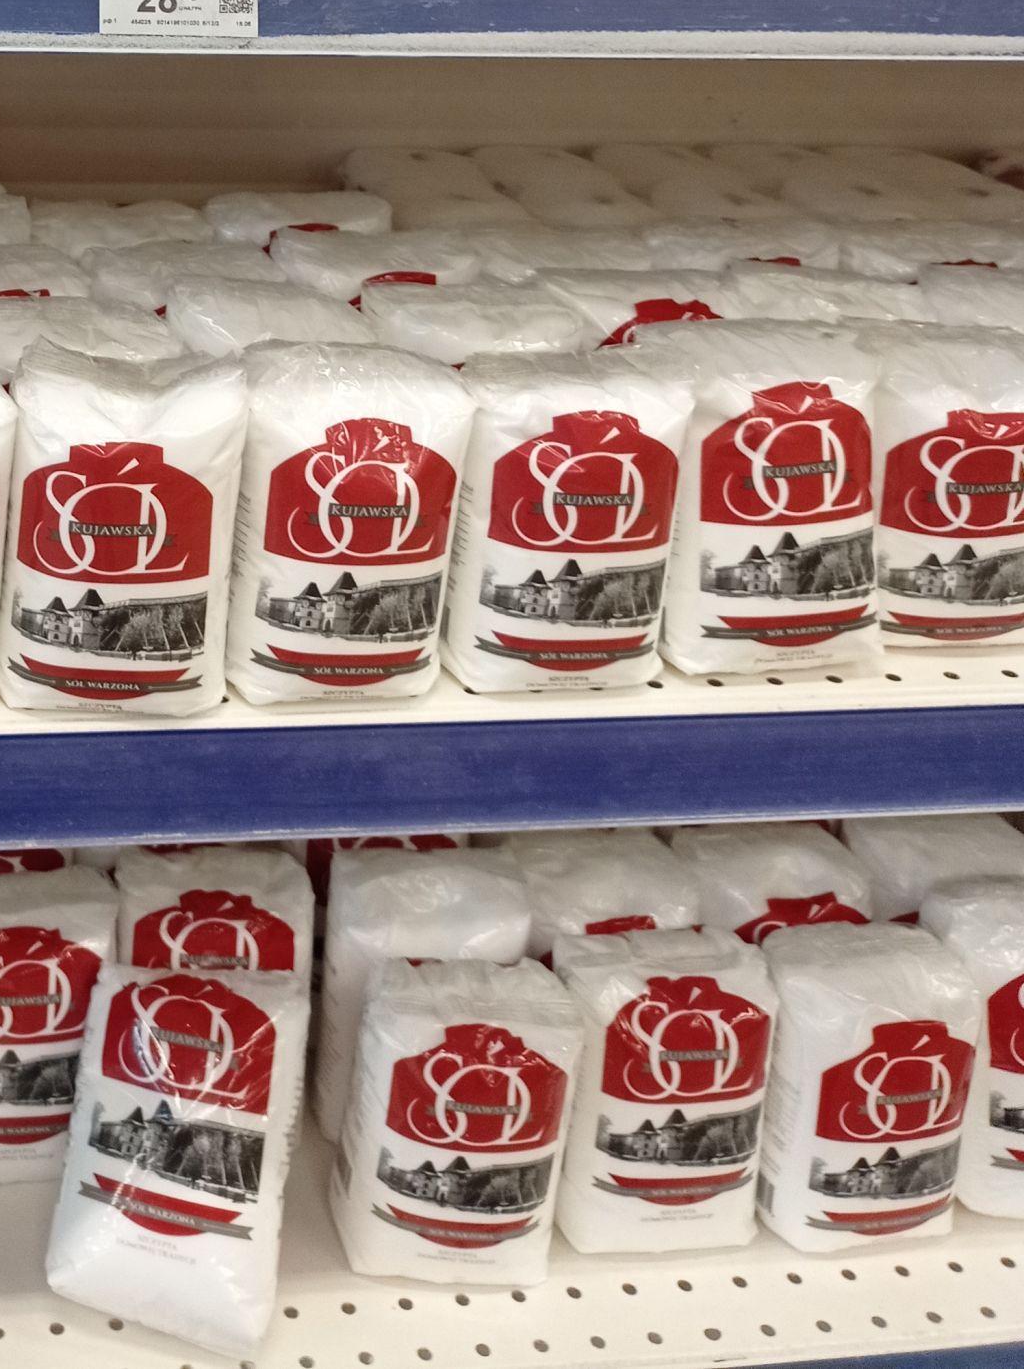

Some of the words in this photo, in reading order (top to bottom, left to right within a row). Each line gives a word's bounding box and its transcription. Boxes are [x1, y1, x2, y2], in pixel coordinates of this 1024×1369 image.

[766, 462, 836, 477] KUJAWSKA
[555, 494, 633, 506] KUJAWSKA
[330, 504, 409, 519] KUJAWSKA
[72, 524, 155, 536] KUJAWSKA
